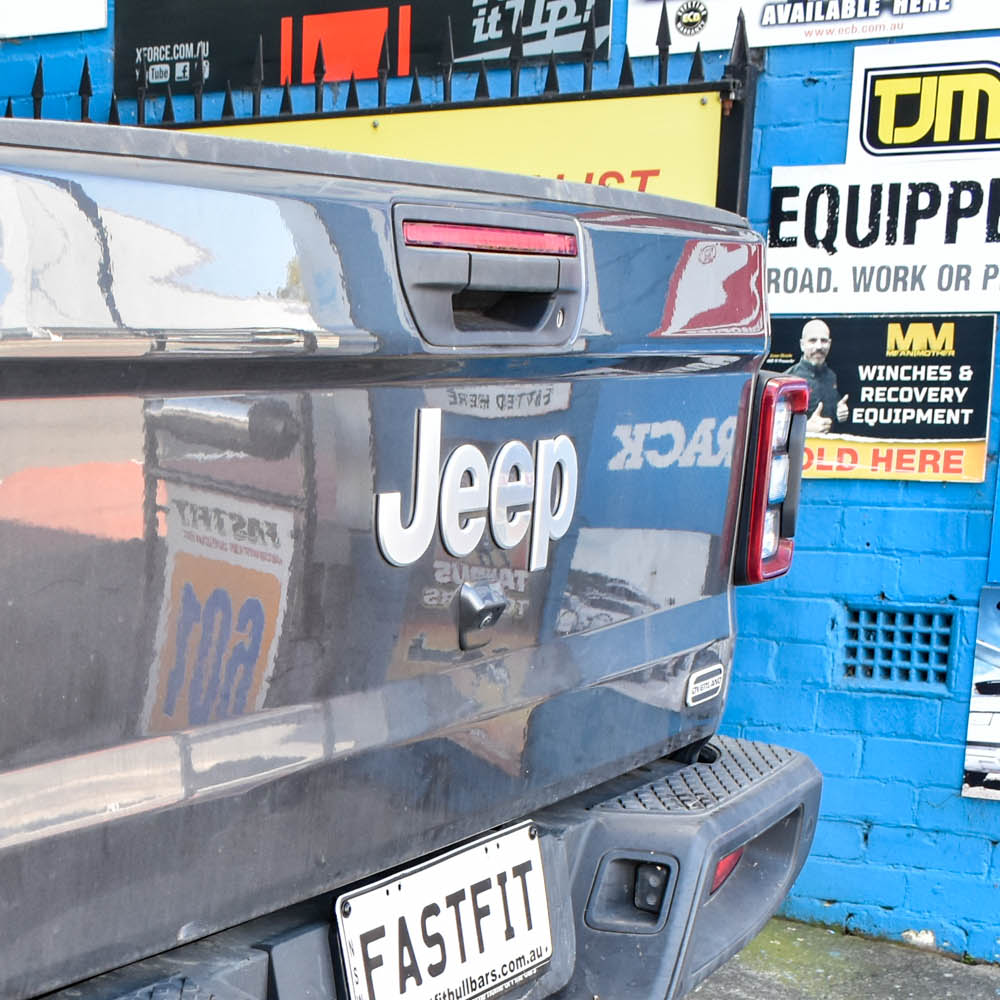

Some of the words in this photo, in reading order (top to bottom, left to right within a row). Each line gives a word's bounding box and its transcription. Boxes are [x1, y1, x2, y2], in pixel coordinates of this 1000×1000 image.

[761, 0, 881, 26] AVAILABLE
[892, 0, 951, 15] HERE
[804, 21, 904, 38] www.ecb.com.au
[874, 72, 1000, 145] TJM
[852, 264, 927, 293] WORK
[937, 264, 972, 291] OR
[886, 322, 955, 351] MM
[858, 365, 952, 382] WINCHES
[959, 365, 974, 381] &
[861, 386, 968, 403] RECOVERY
[852, 408, 974, 426] EQUIPMENT
[871, 448, 965, 474] HERE
[375, 407, 579, 572] Jeep
